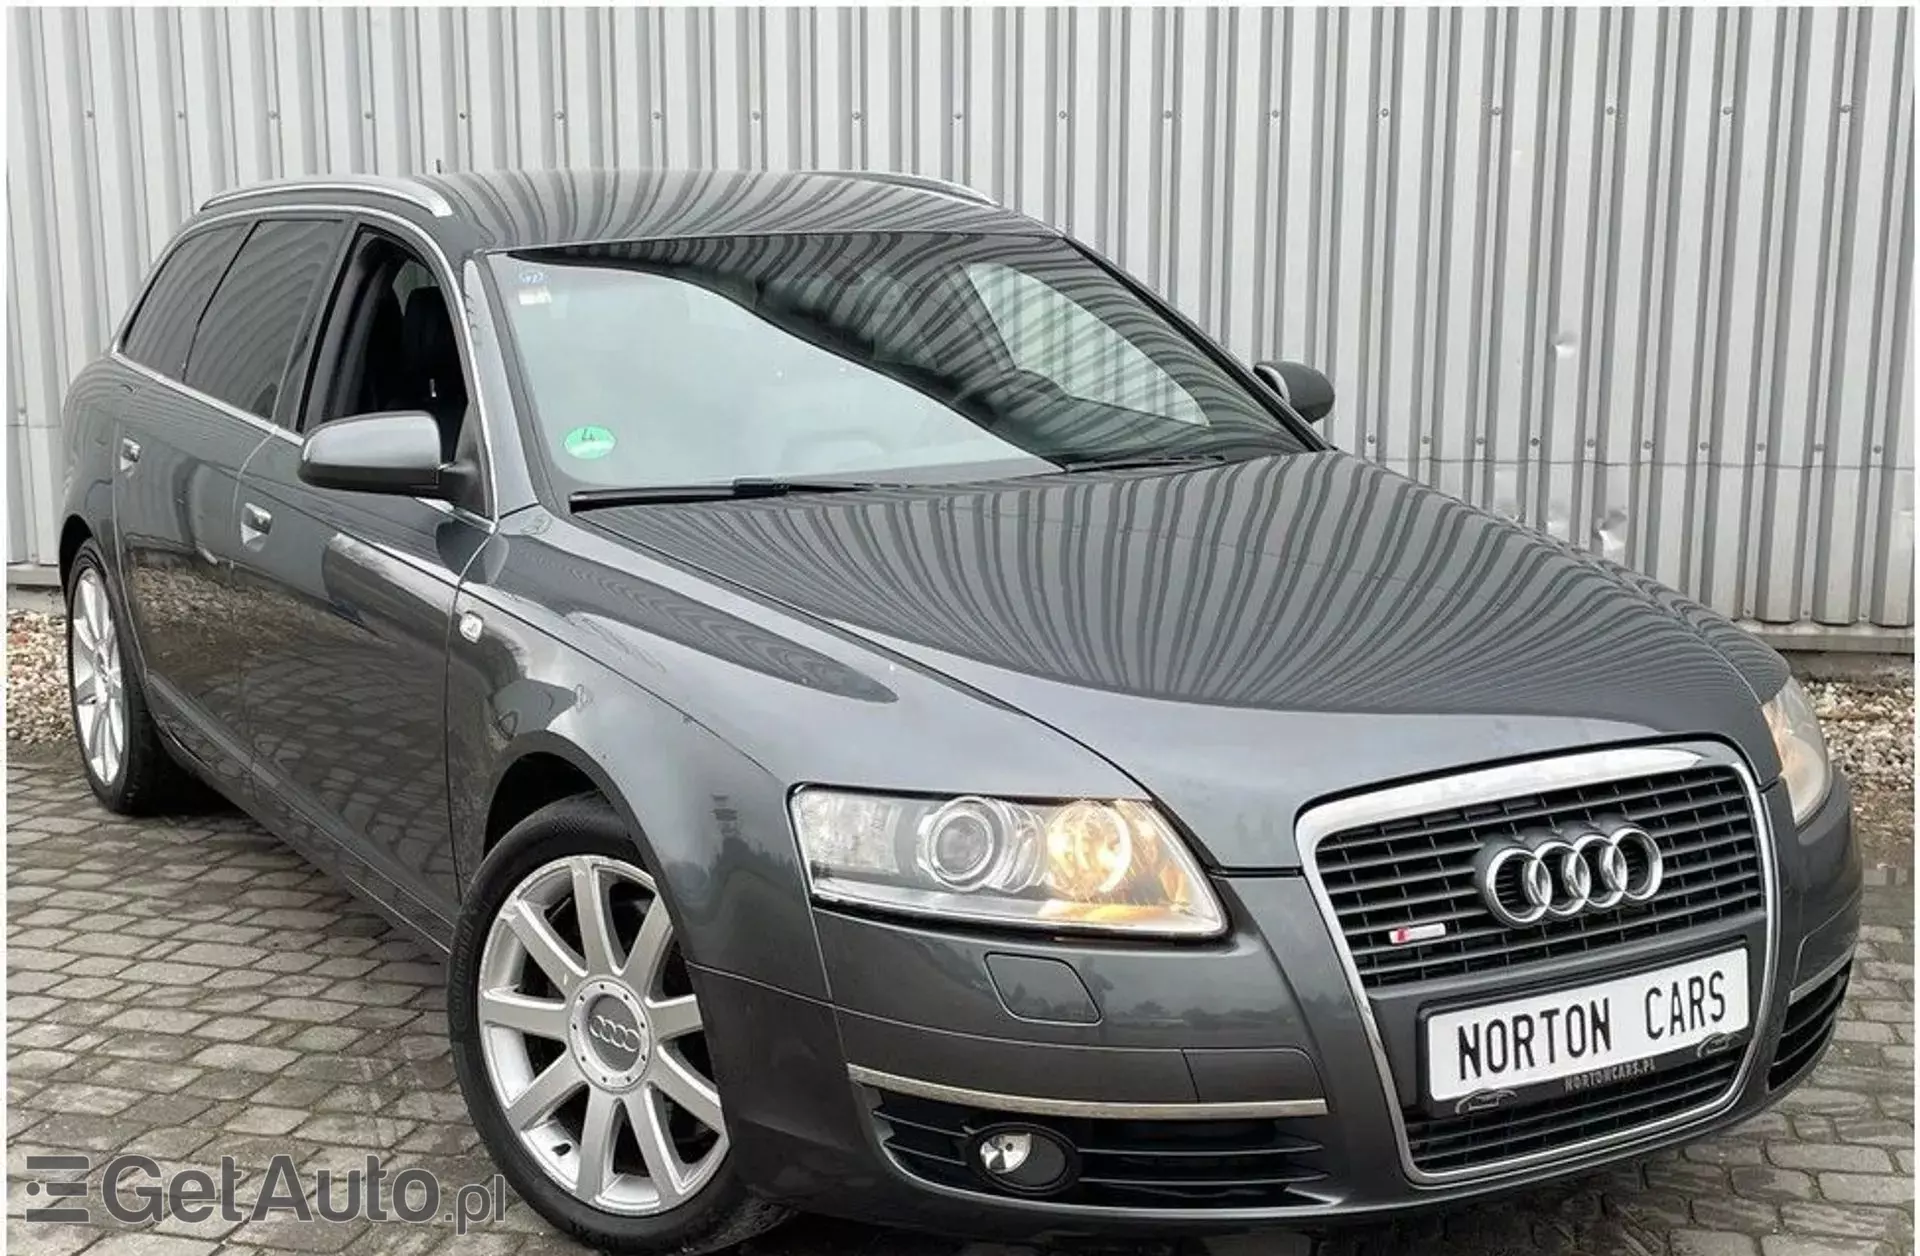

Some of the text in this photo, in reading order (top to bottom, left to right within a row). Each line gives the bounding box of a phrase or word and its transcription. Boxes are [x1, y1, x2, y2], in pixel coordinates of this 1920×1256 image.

[581, 427, 594, 442] 4
[1457, 970, 1727, 1080] NORTON CARS
